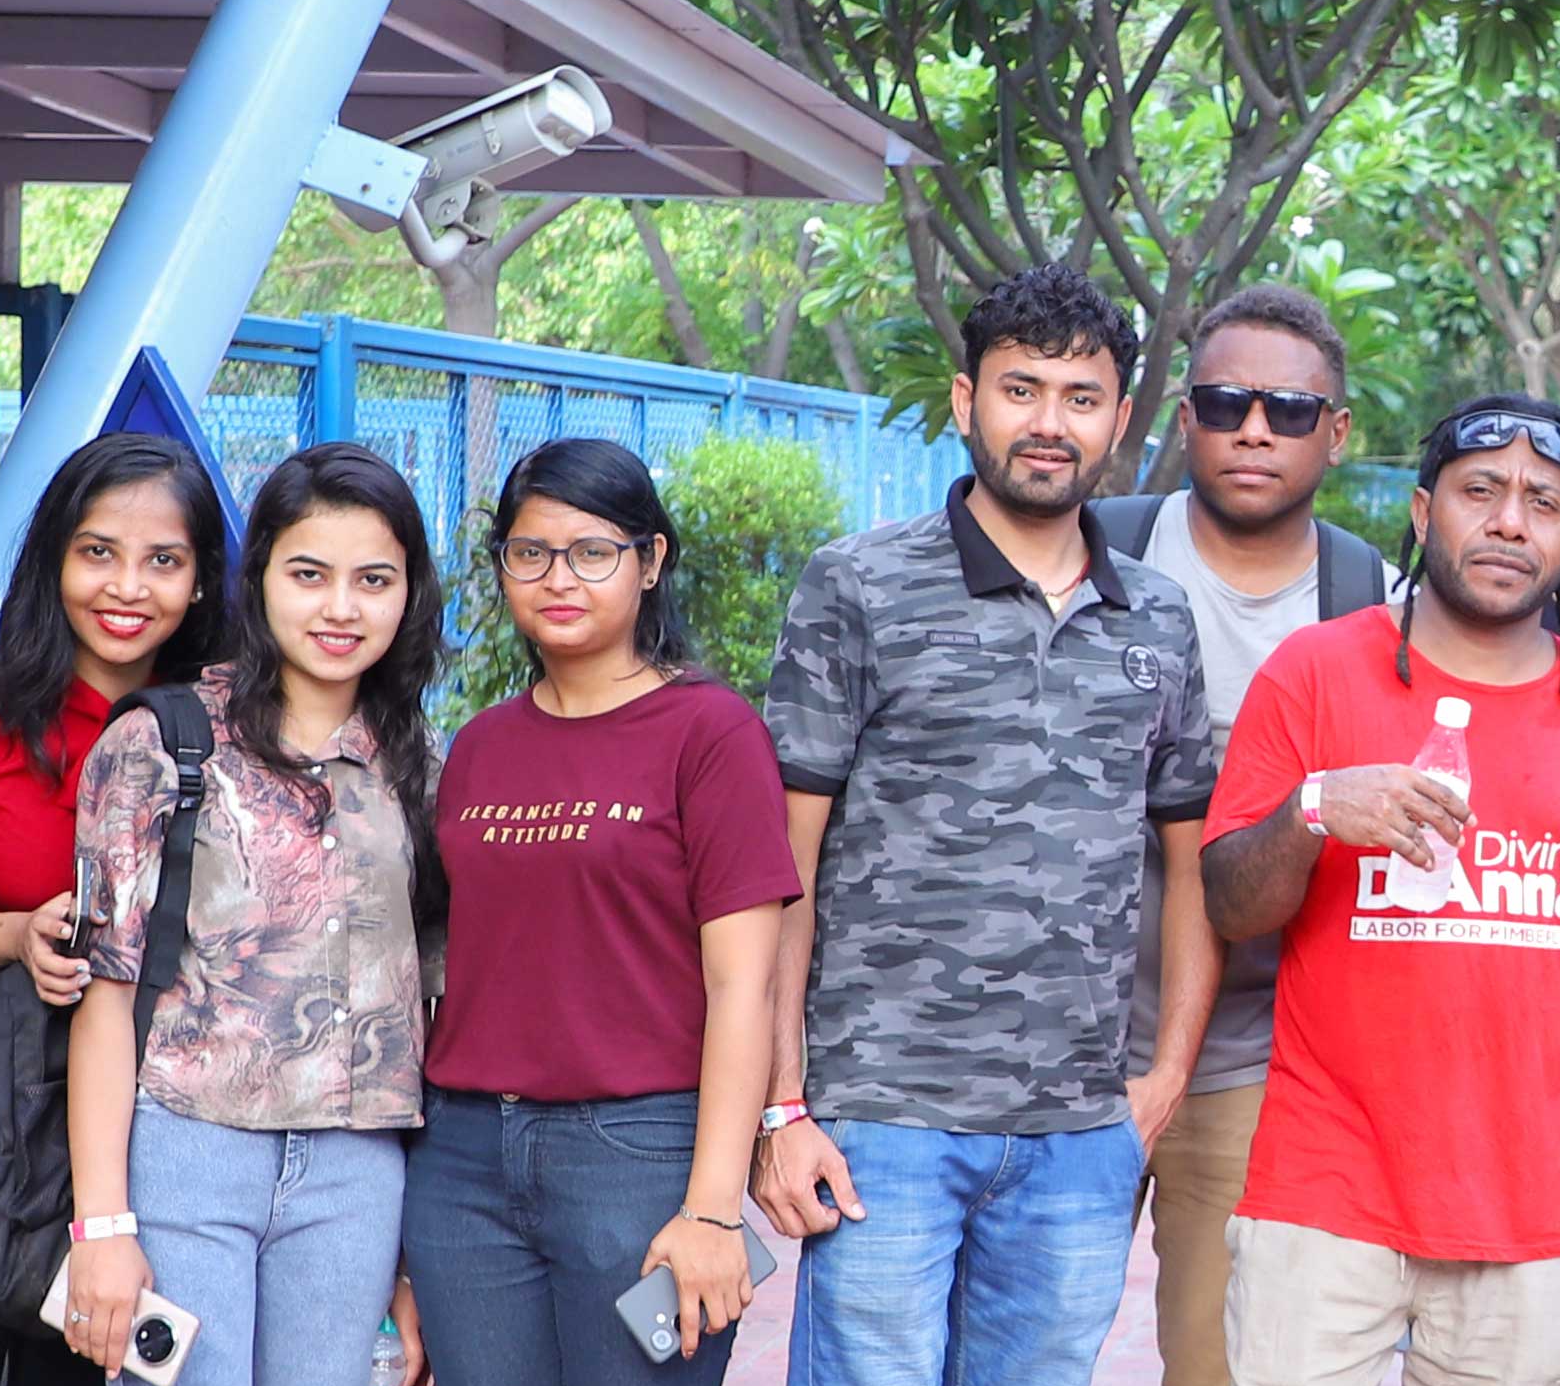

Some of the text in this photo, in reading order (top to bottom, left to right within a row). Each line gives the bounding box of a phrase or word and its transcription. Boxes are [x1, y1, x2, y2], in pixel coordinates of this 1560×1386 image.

[459, 800, 644, 823] ELEGANCE IS AN
[481, 823, 590, 845] ATTITUDE
[1353, 920, 1427, 938] LABOR
[1434, 922, 1481, 939] FOR
